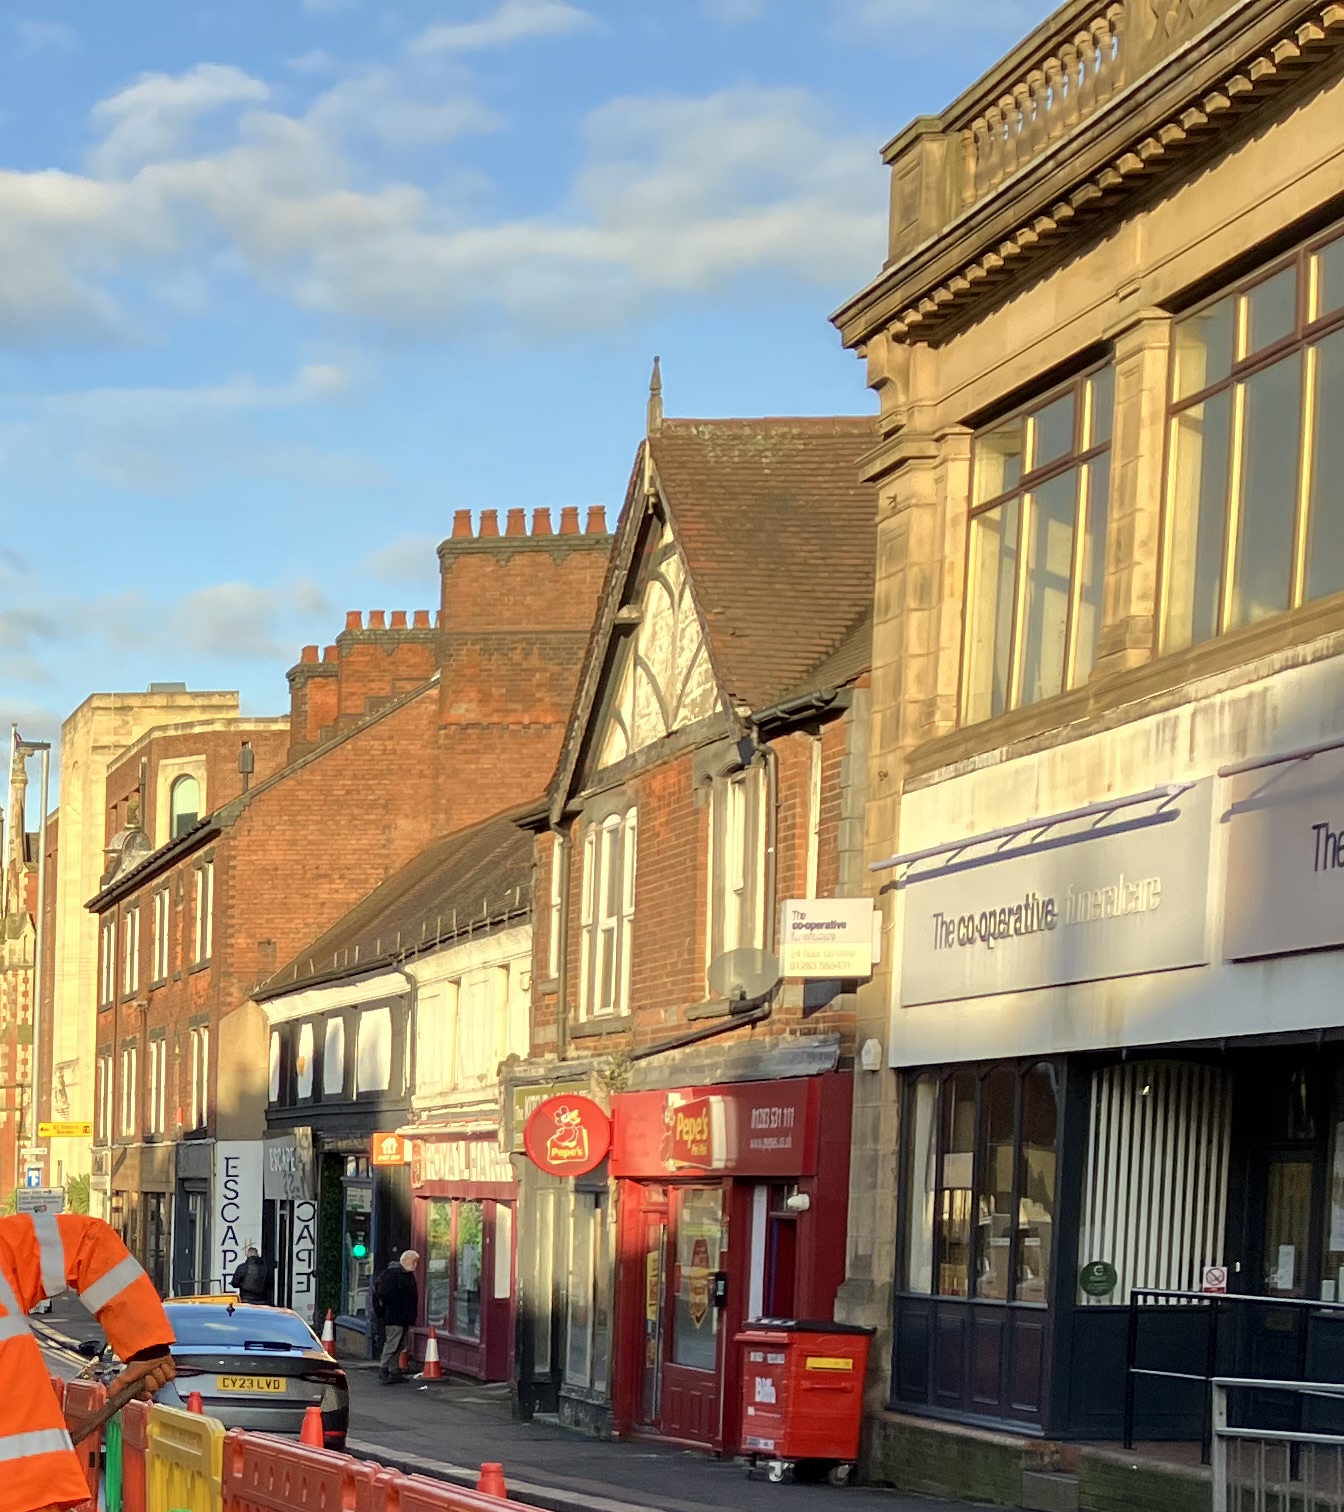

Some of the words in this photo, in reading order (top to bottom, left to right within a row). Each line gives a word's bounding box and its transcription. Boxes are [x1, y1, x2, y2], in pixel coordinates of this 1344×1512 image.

[932, 912, 955, 950] The
[676, 1107, 709, 1149] Pepe's
[269, 1147, 296, 1172] ESCAPE
[551, 1146, 583, 1158] Pepe's
